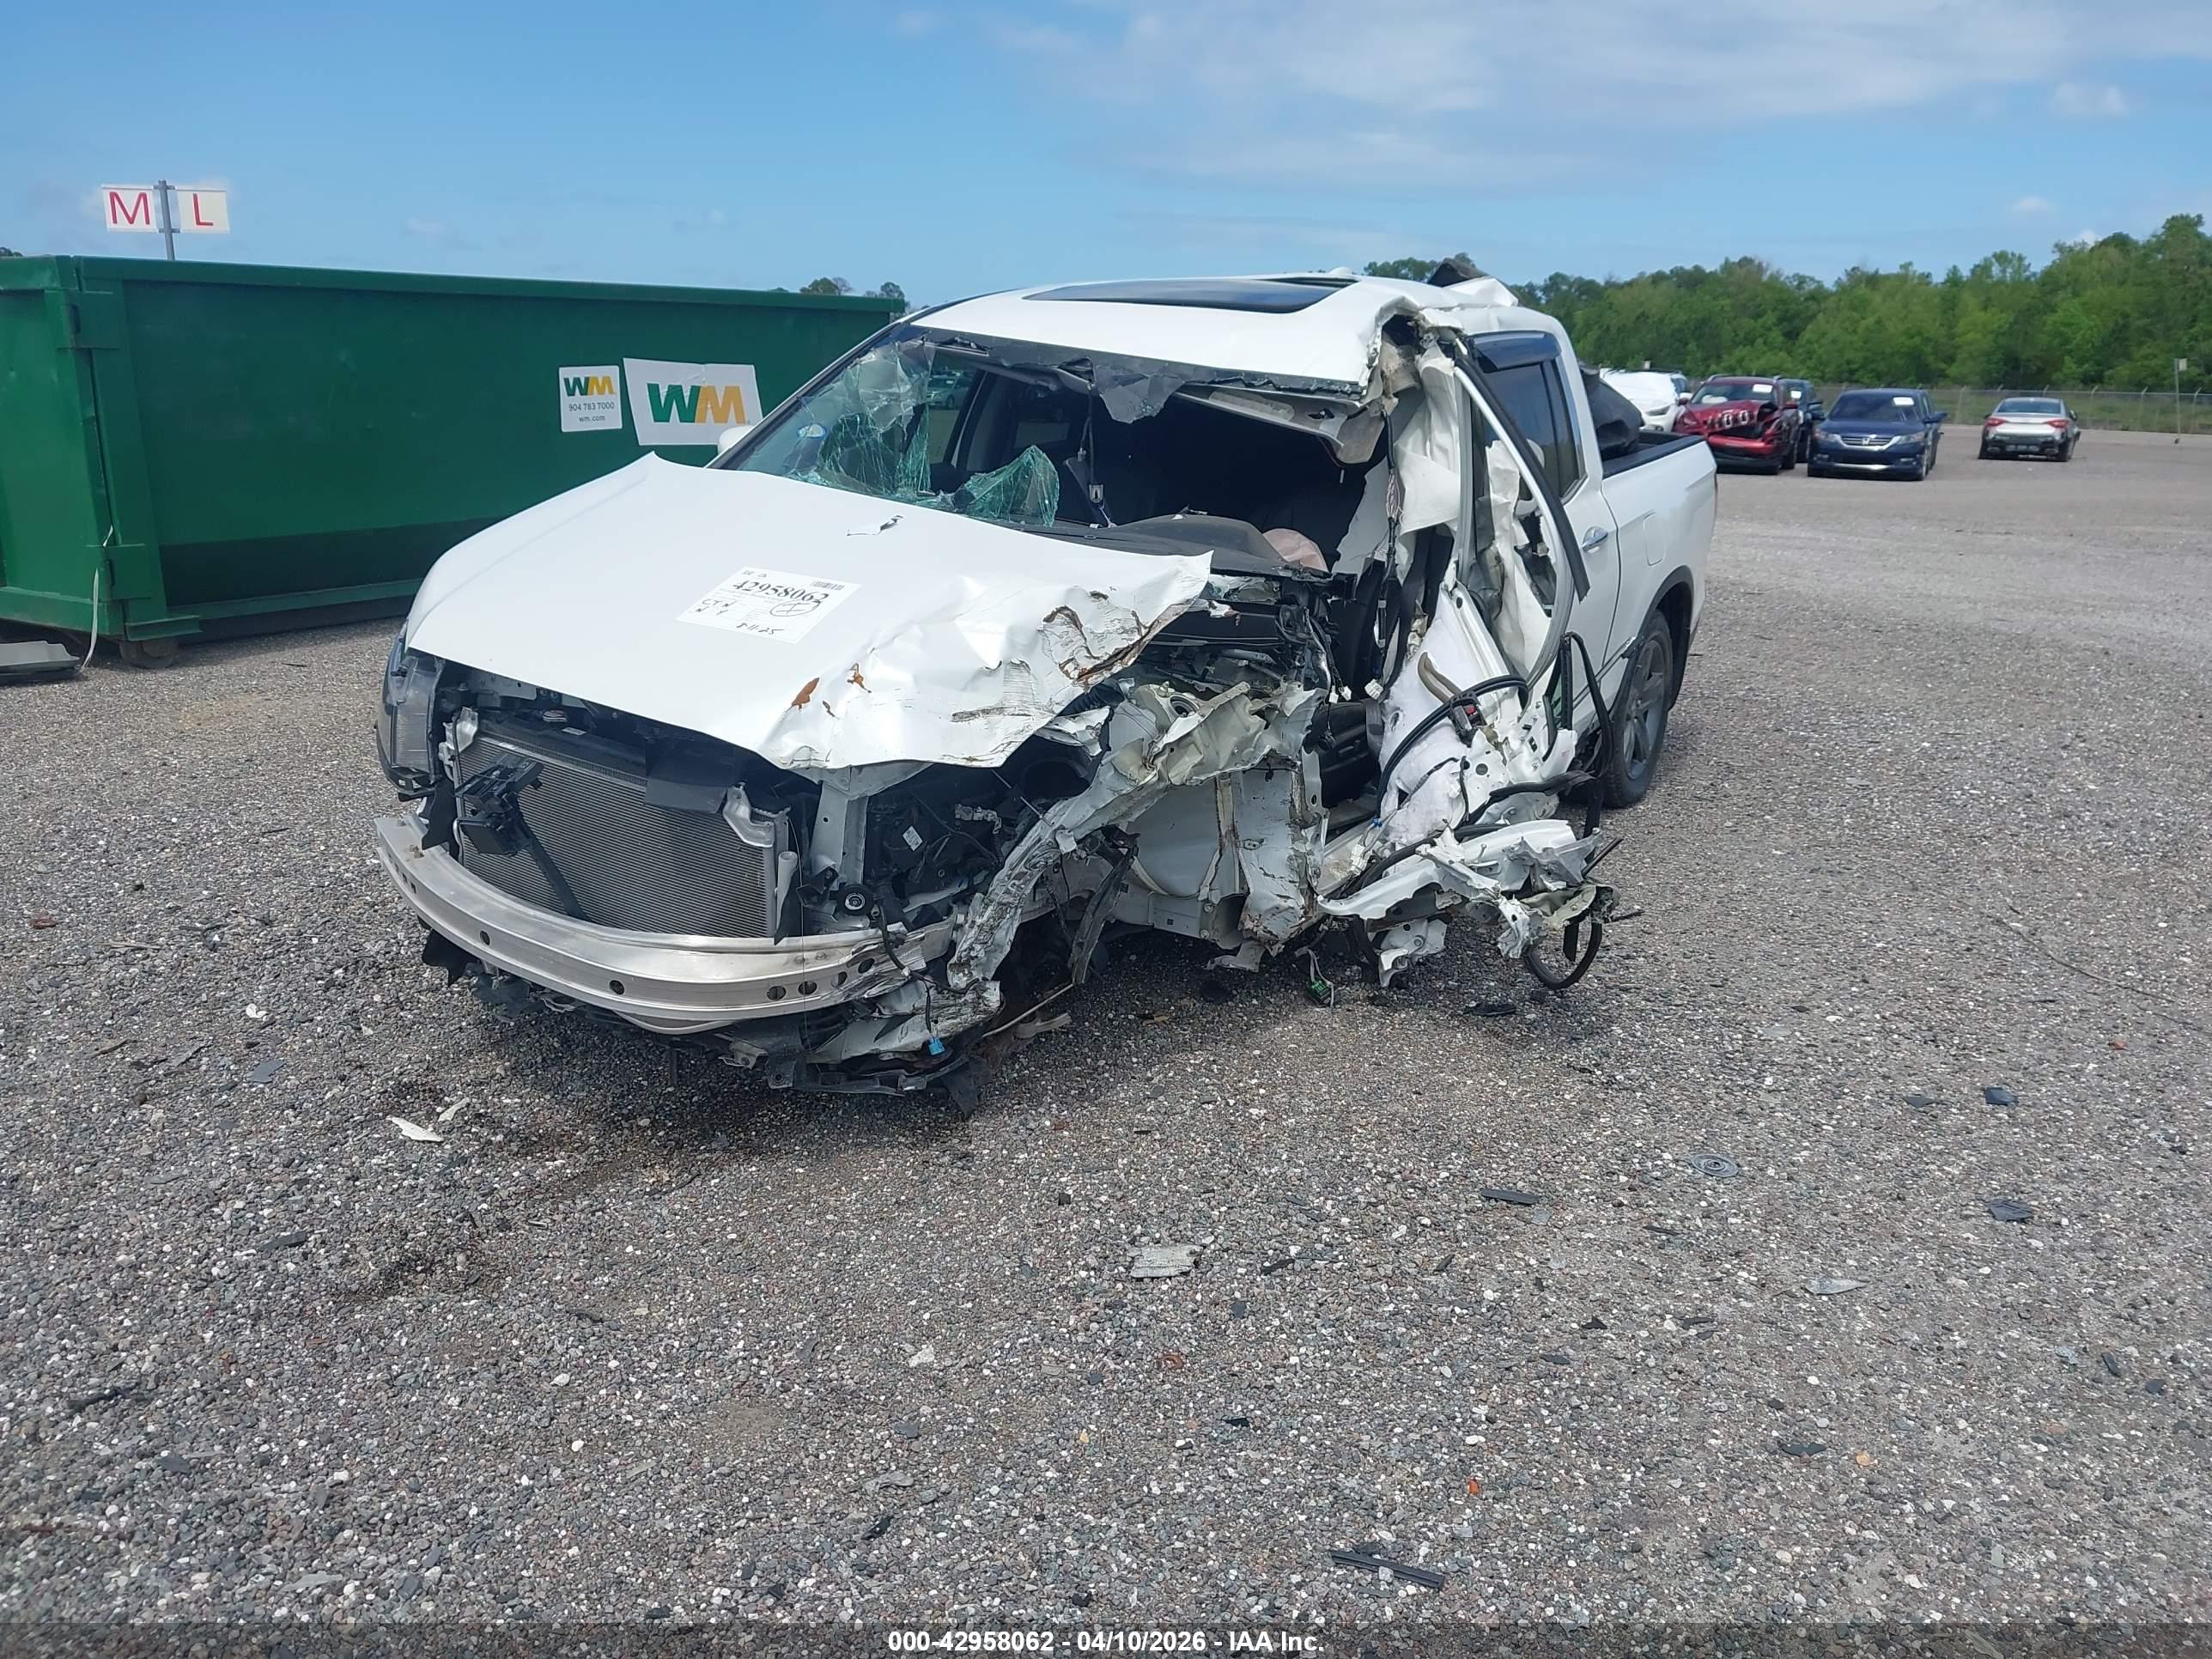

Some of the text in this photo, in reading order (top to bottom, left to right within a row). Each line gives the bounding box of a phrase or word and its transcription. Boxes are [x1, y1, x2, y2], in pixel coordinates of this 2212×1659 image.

[109, 191, 150, 225] M
[192, 193, 214, 226] L
[562, 376, 616, 397] WM
[597, 401, 615, 410] 7000
[646, 383, 747, 425] WM
